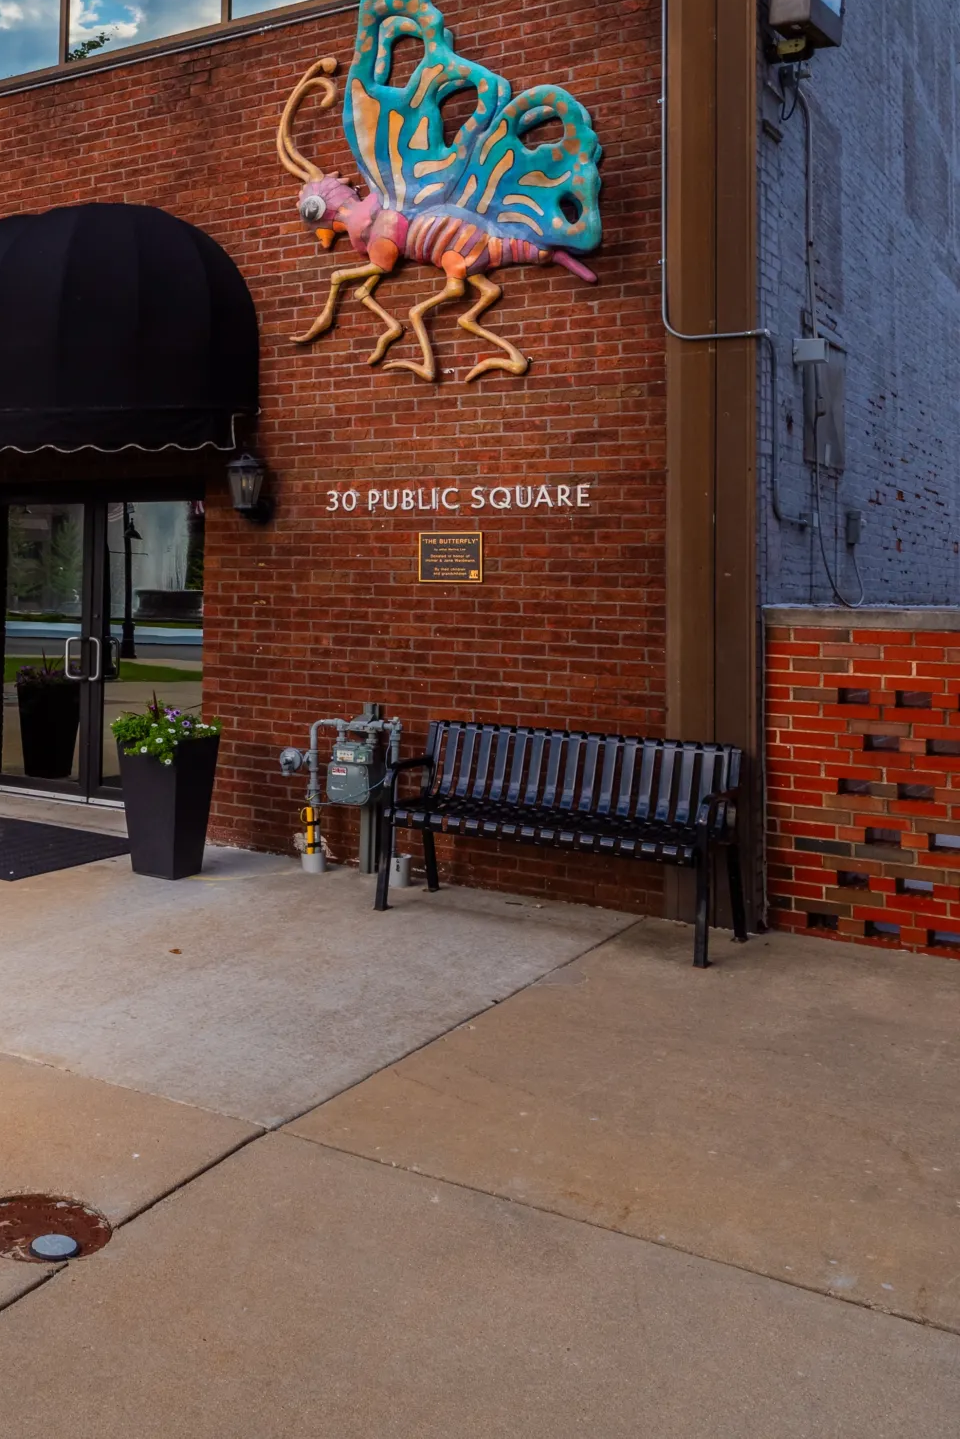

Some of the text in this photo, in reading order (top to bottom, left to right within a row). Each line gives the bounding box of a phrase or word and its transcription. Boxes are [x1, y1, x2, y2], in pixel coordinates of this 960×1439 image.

[325, 484, 591, 512] 30 PUBLIC SQUARE
